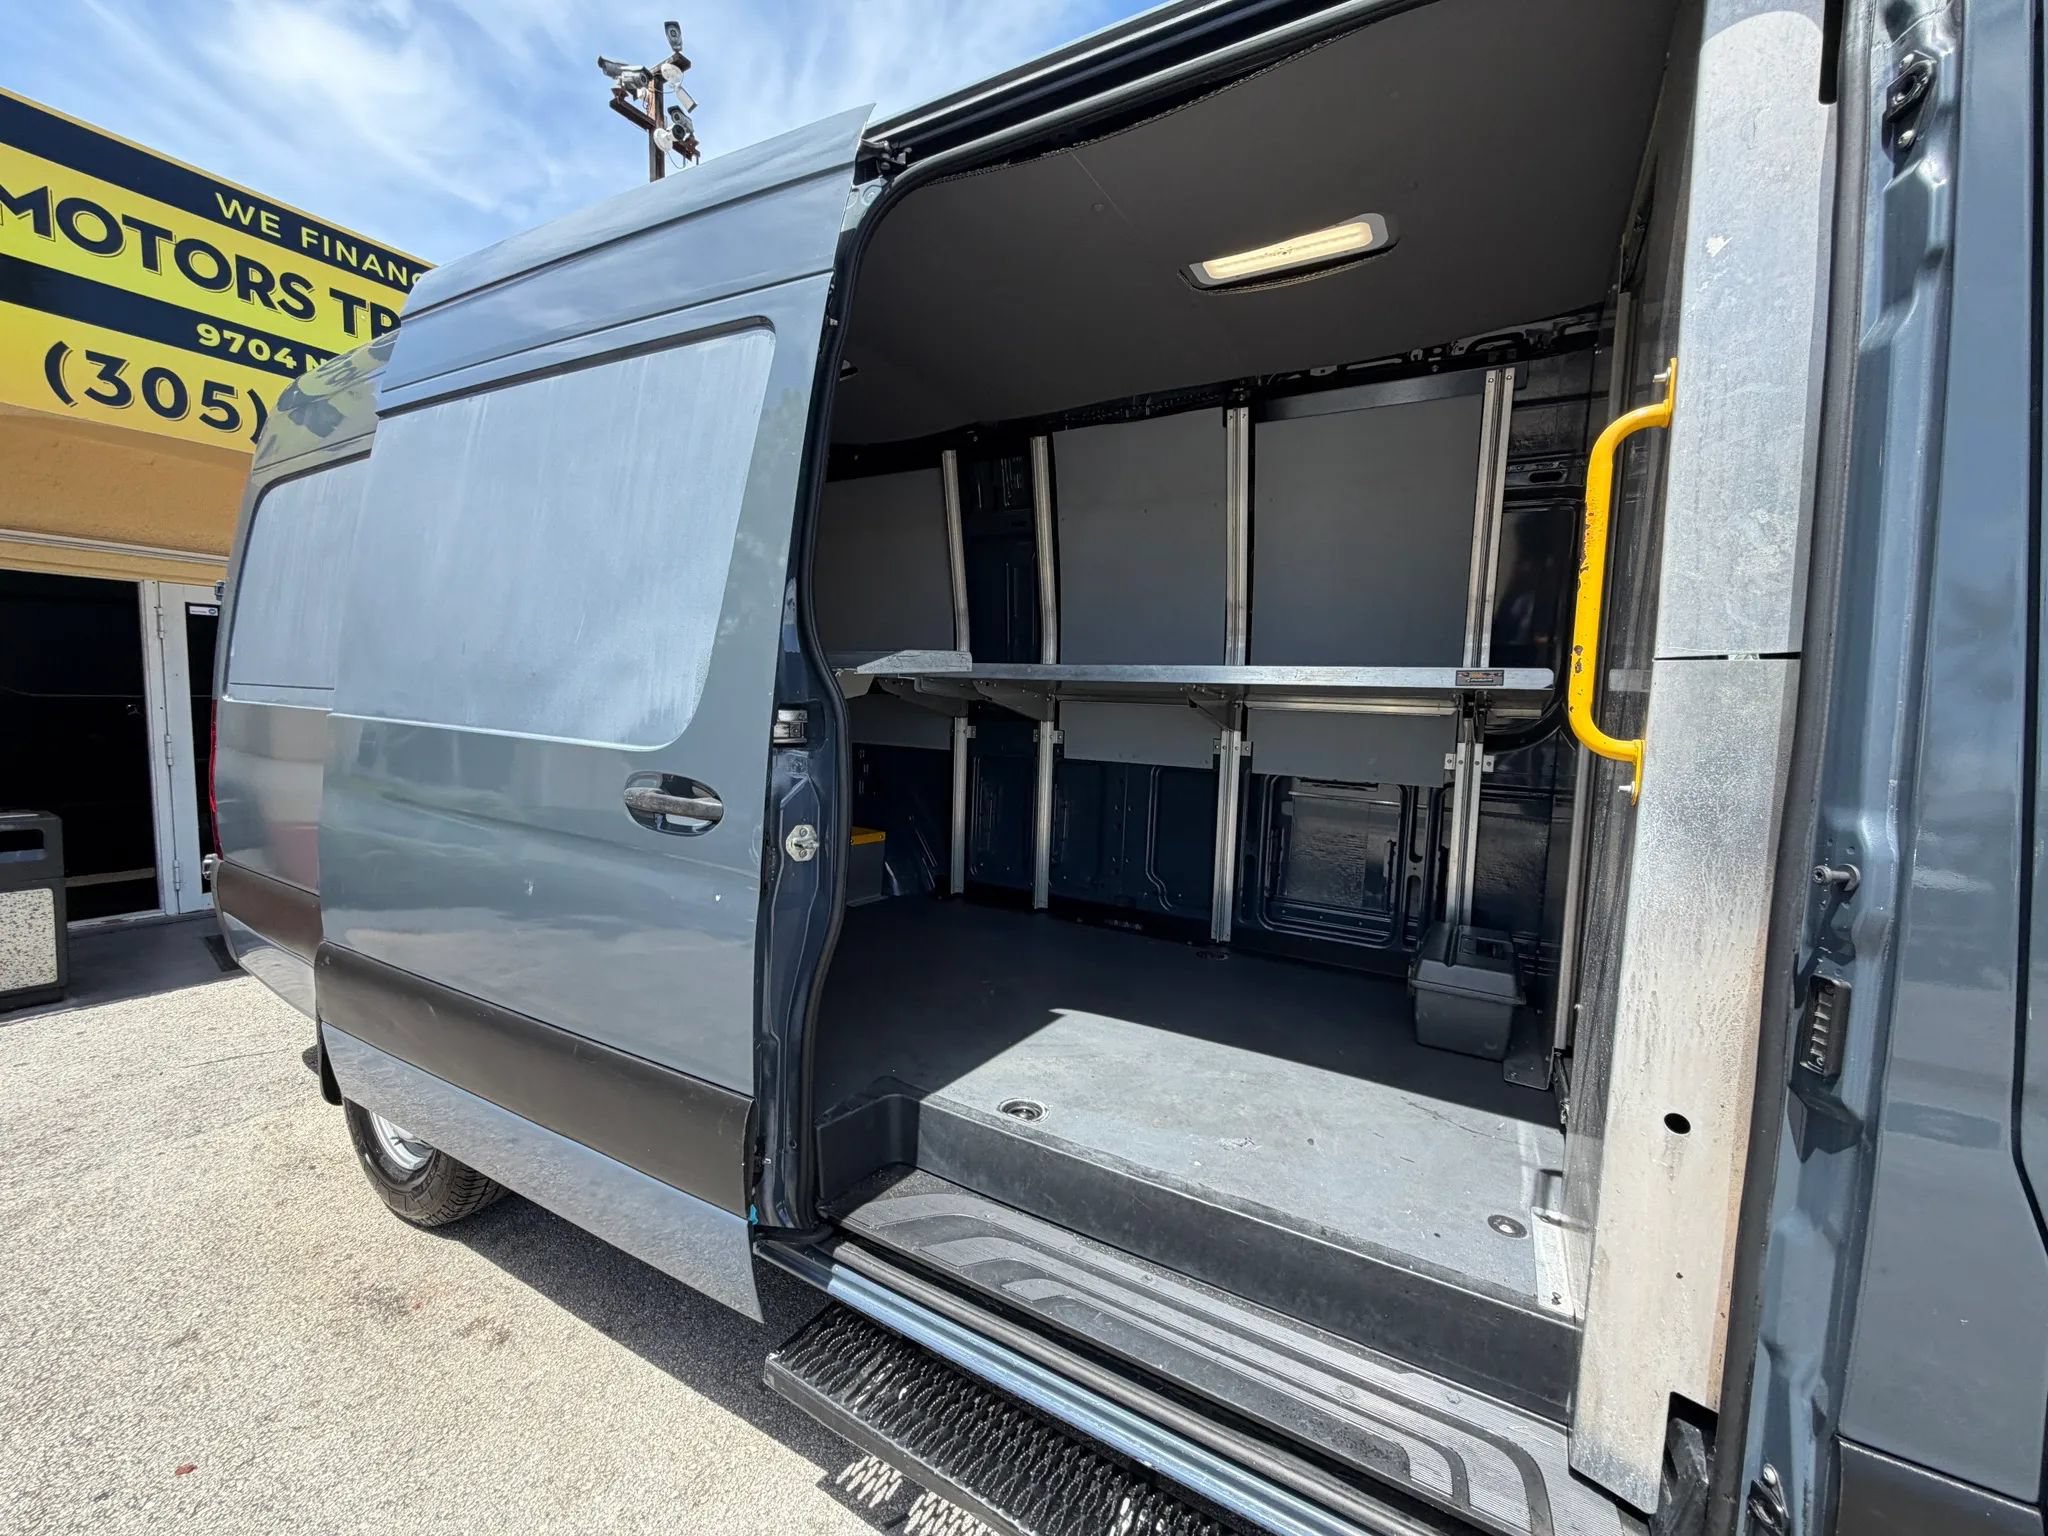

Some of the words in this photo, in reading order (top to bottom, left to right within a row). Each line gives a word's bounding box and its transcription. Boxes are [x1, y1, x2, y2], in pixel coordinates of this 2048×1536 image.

[0, 184, 315, 321] MOTORS
[215, 192, 281, 238] WE
[196, 323, 297, 369] 9704
[44, 340, 268, 444] (305)
